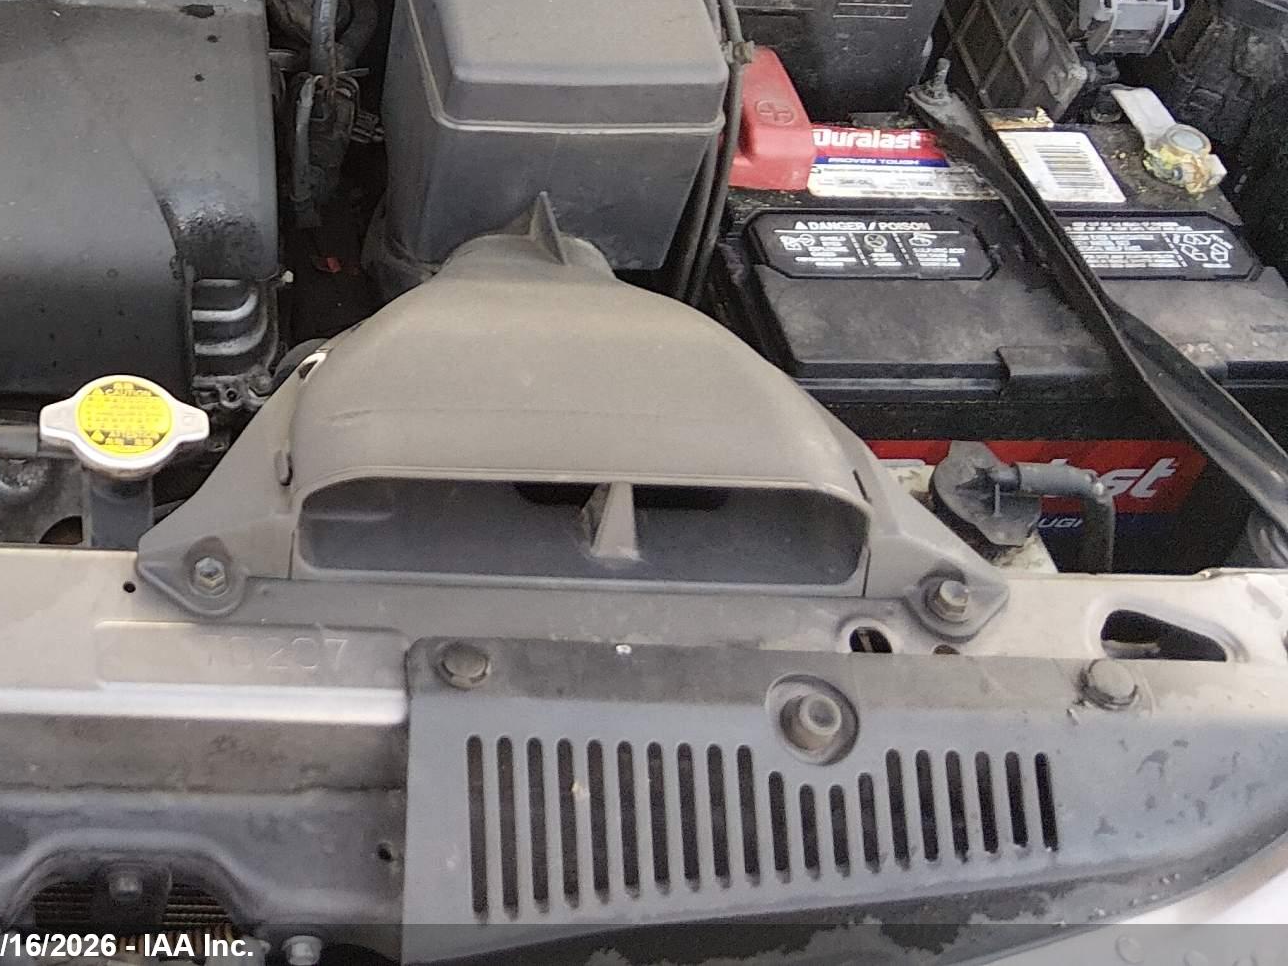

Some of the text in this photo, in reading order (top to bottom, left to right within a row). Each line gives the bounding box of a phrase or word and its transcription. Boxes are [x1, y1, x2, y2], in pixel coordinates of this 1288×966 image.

[813, 128, 921, 149] Duralast
[807, 221, 867, 231] DANGER
[878, 222, 931, 231] POISON
